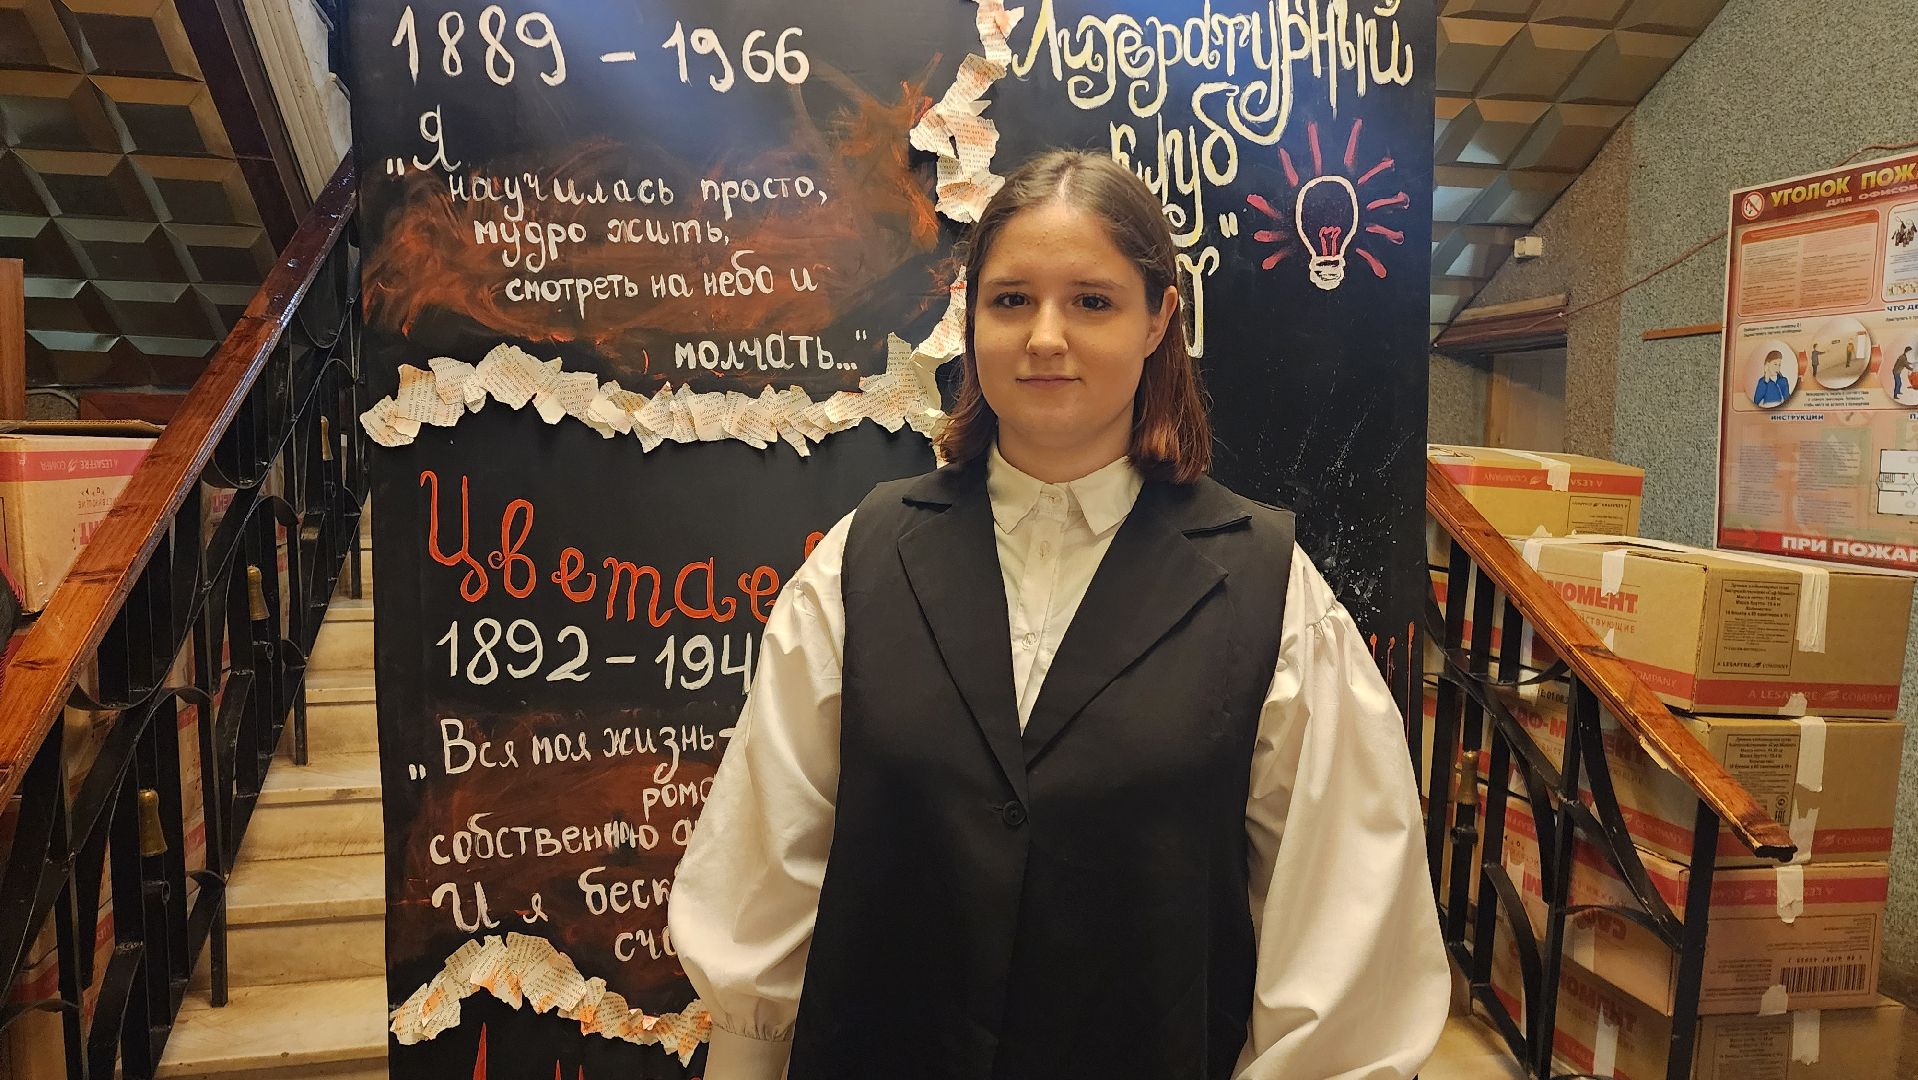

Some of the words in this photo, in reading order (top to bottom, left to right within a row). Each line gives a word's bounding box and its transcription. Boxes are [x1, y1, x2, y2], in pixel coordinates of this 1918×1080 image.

[392, 4, 567, 87] 1889
[662, 20, 810, 93] 1966
[449, 173, 675, 222] научилась
[701, 174, 828, 220] просто,
[1771, 176, 1851, 208] УГОЛОК
[1861, 162, 1918, 190] ПОЖ
[473, 218, 587, 273] мудро
[606, 216, 730, 247] жить,
[505, 273, 639, 320] смотреть
[650, 272, 694, 298] на
[704, 250, 774, 297] небо
[790, 266, 818, 293] и
[1770, 413, 1824, 421] ИНСТРУКЦИИ
[1782, 536, 1827, 553] ПРИ
[1832, 541, 1918, 563] ПОЖАР
[435, 617, 592, 686] 1892
[431, 881, 501, 933] И
[522, 892, 549, 924] я
